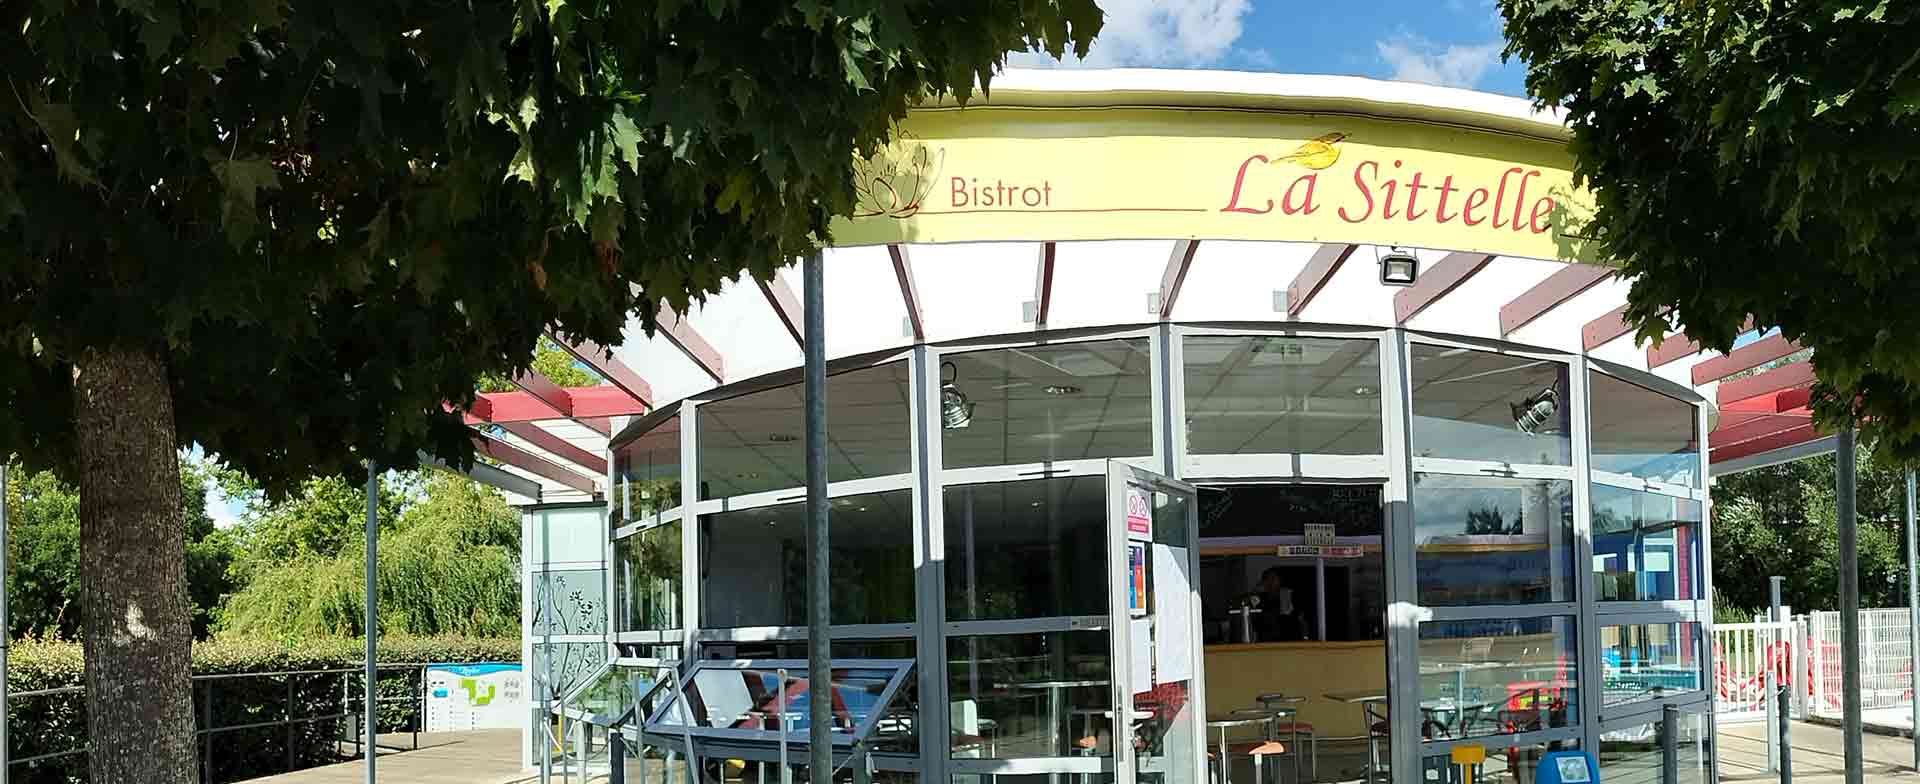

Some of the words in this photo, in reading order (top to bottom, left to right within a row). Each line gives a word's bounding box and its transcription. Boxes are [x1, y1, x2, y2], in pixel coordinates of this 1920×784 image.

[951, 176, 1052, 207] Bistrot
[1220, 154, 1321, 215] La
[1338, 159, 1557, 234] Sittelle
